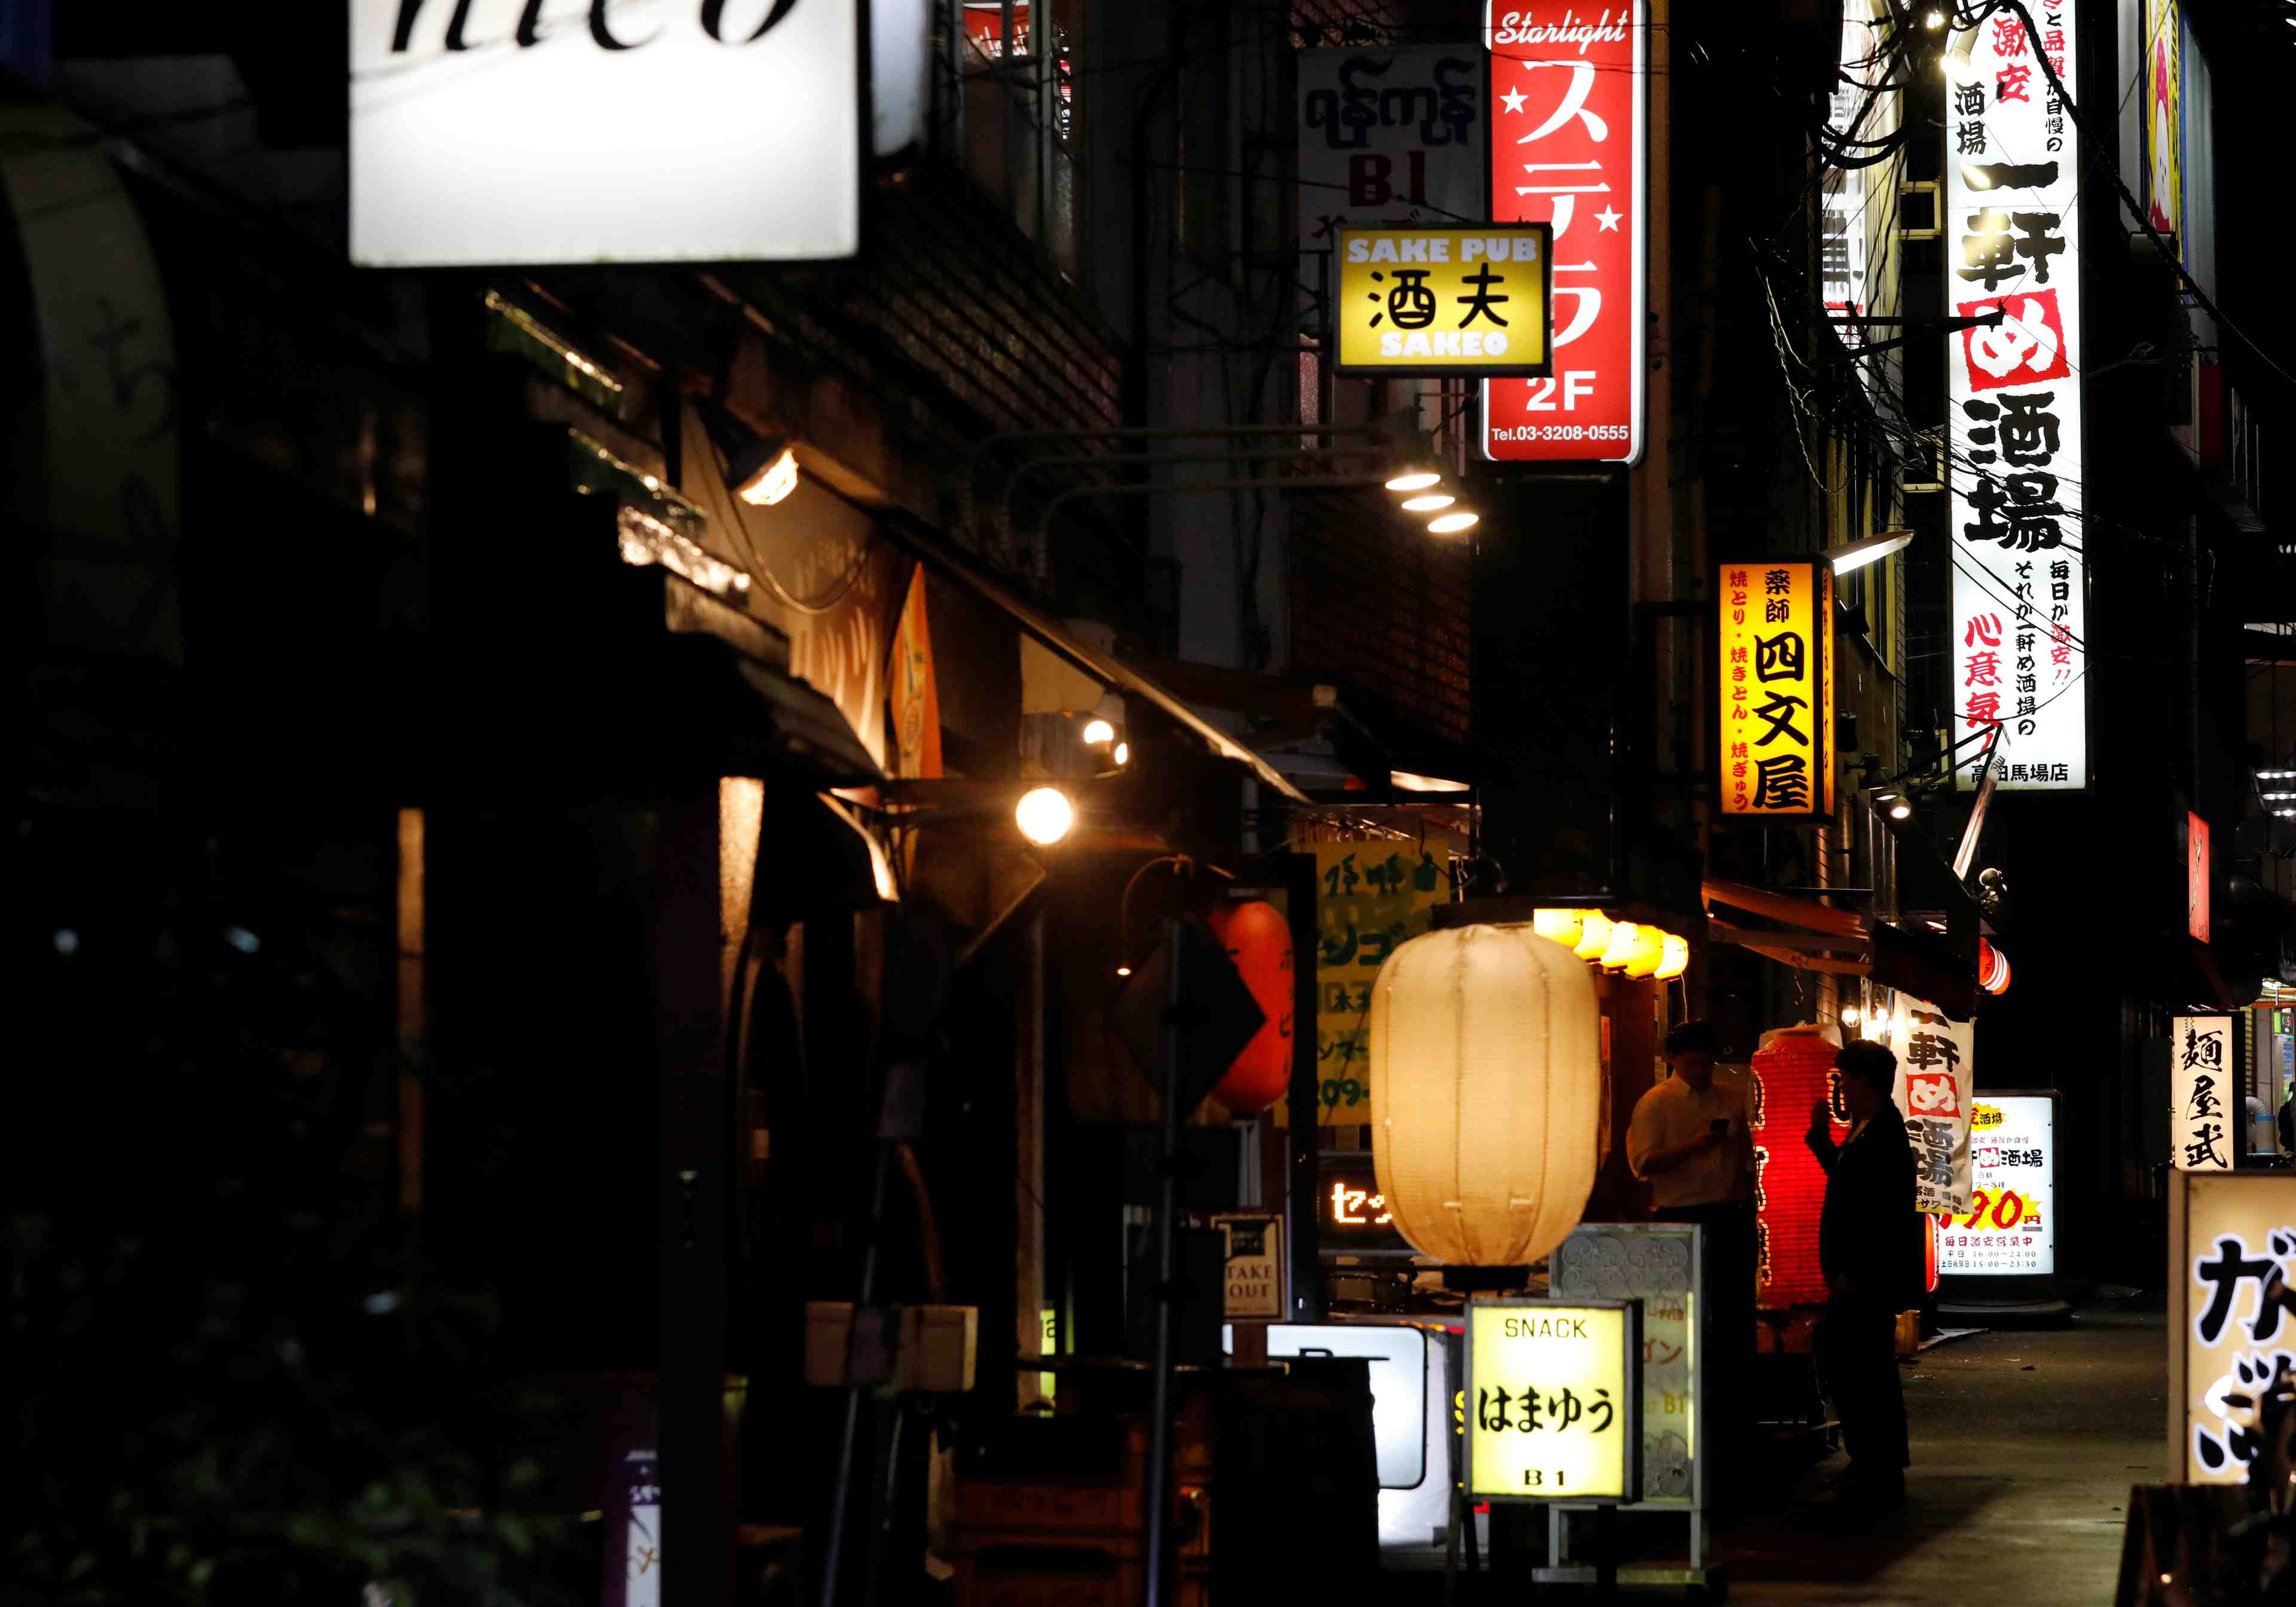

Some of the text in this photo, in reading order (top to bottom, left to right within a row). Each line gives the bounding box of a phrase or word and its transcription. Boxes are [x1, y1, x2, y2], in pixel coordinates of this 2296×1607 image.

[1495, 9, 1628, 54] Starlight
[1993, 17, 2031, 103] 激安
[1955, 81, 1986, 155] 酒場
[1516, 60, 1611, 349] ステラ
[1348, 237, 1537, 263] SAKE PUB
[1368, 263, 1509, 329] 酒夫
[1380, 332, 1509, 356] SAKEO
[1956, 161, 2067, 552] 一軒め酒場
[1526, 371, 1596, 411] 2F
[2015, 561, 2036, 736] それが一軒め酒場の
[1752, 570, 1809, 809] 薬師 四文屋
[1906, 1010, 1961, 1188] 一軒め酒場
[1227, 1264, 1273, 1279] TAKE
[1229, 1283, 1268, 1298] OUT
[1506, 1318, 1588, 1338] SNACK
[1479, 1386, 1613, 1433] はまゆう
